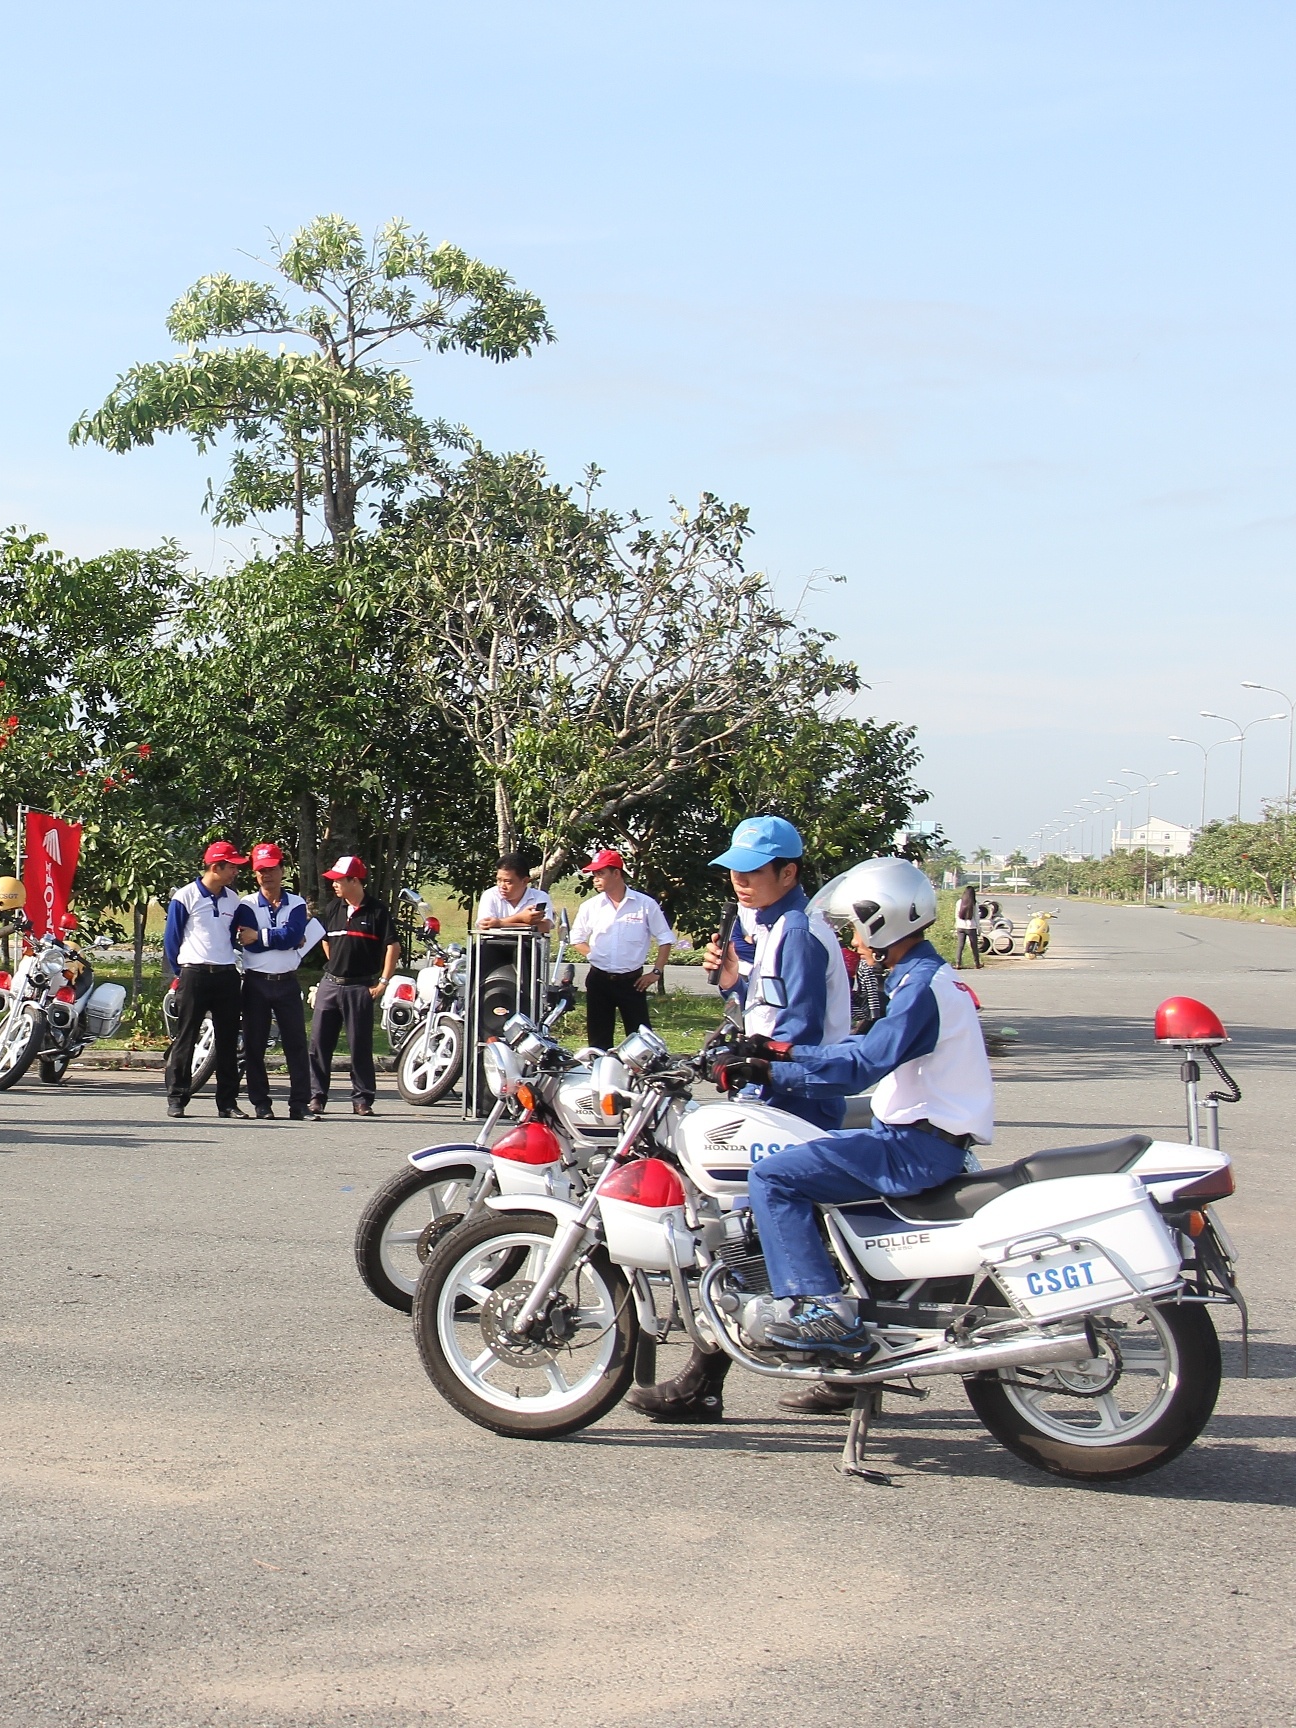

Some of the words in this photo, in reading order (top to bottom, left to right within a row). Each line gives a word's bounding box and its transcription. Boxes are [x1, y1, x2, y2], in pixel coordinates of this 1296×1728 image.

[750, 1143, 796, 1164] CS
[865, 1233, 931, 1250] POLICE
[1027, 1262, 1094, 1295] CSGT
